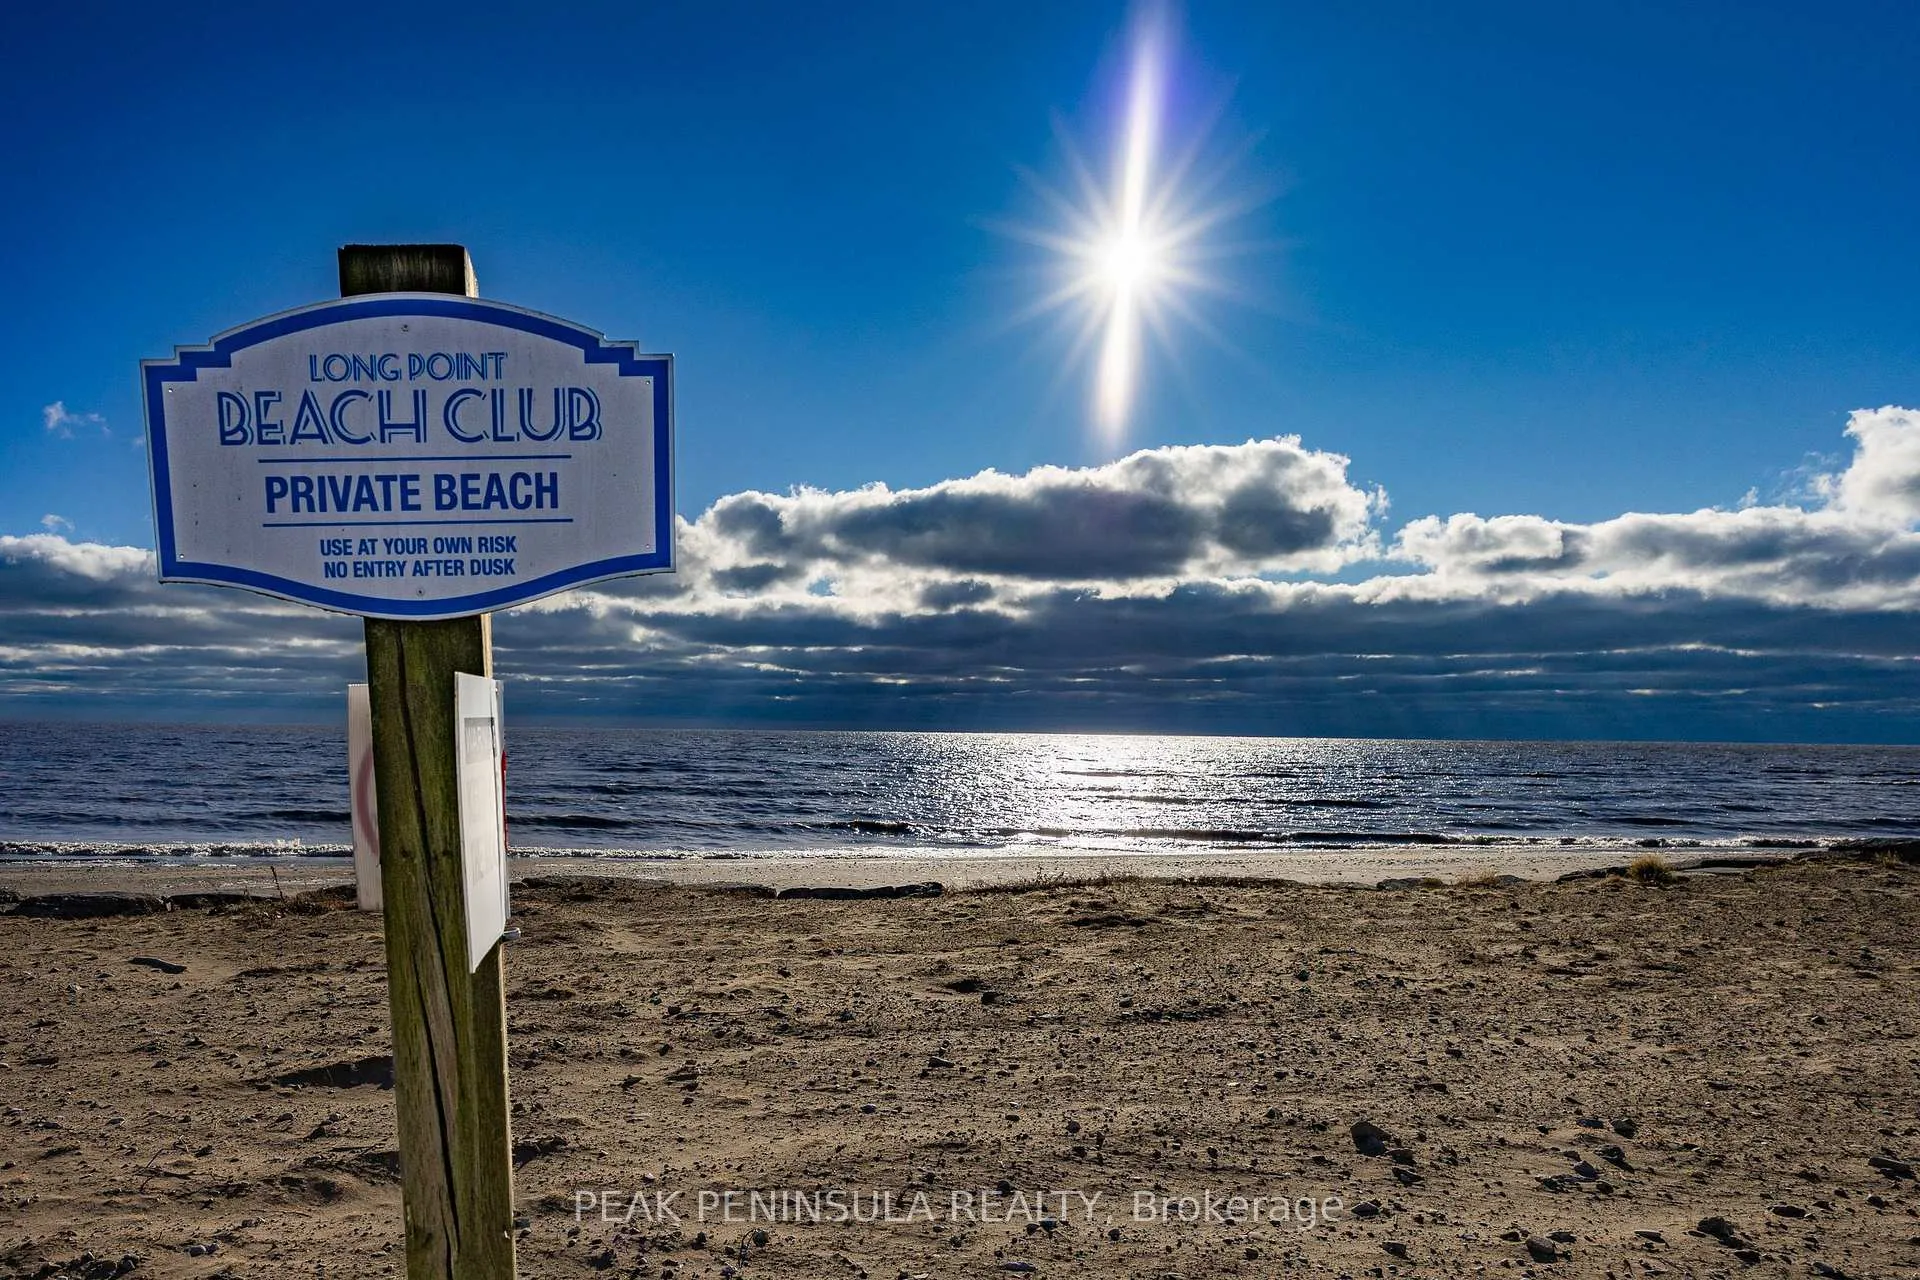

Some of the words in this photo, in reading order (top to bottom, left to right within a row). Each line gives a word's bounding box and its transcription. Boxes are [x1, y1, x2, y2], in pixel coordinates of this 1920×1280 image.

[309, 354, 400, 382] LONG
[408, 352, 508, 381] POINT
[217, 389, 428, 446] BEACH
[443, 387, 602, 443] CLUB
[264, 474, 422, 514] PRIVATE
[433, 471, 560, 511] BEACH
[319, 539, 353, 556] USE
[357, 538, 378, 555] AT
[382, 538, 428, 555] YOUR
[432, 536, 473, 554] OWN
[477, 535, 518, 553] RISK
[323, 560, 348, 579] NO
[352, 560, 407, 578] ENTRY
[411, 559, 466, 577] AFTER
[469, 557, 516, 576] DUSK
